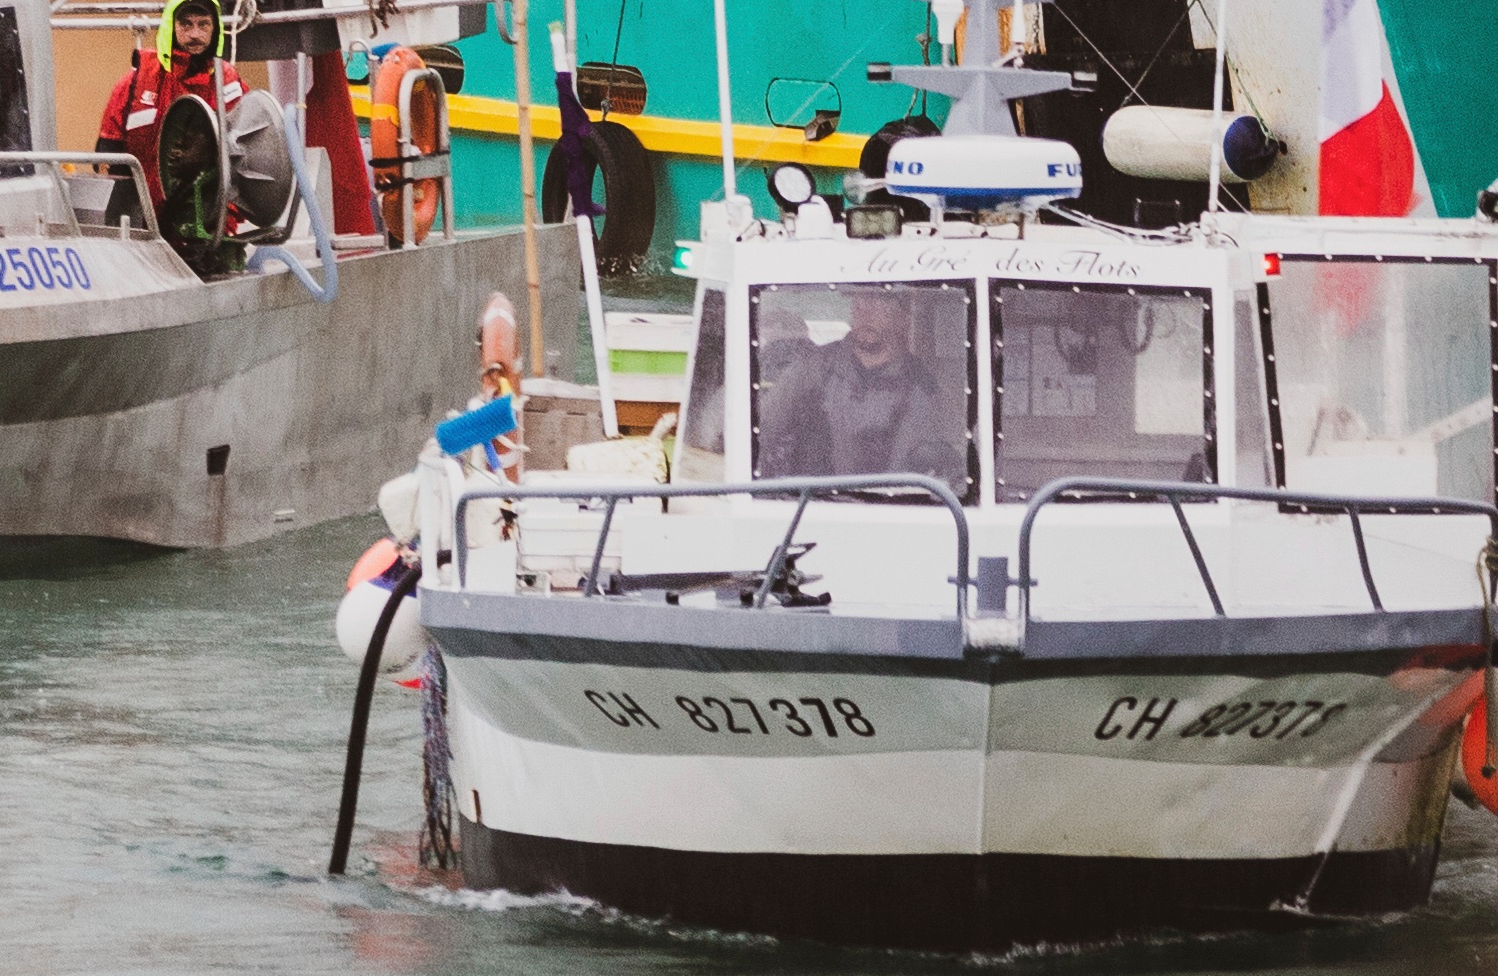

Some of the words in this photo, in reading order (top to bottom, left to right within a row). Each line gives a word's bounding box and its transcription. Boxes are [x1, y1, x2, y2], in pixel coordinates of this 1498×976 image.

[1047, 163, 1082, 177] FU
[840, 246, 898, 273] Au
[996, 247, 1044, 272] des
[1056, 250, 1141, 277] Flots
[583, 689, 660, 729] CH
[674, 695, 876, 738] 827378
[1094, 696, 1179, 741] CH
